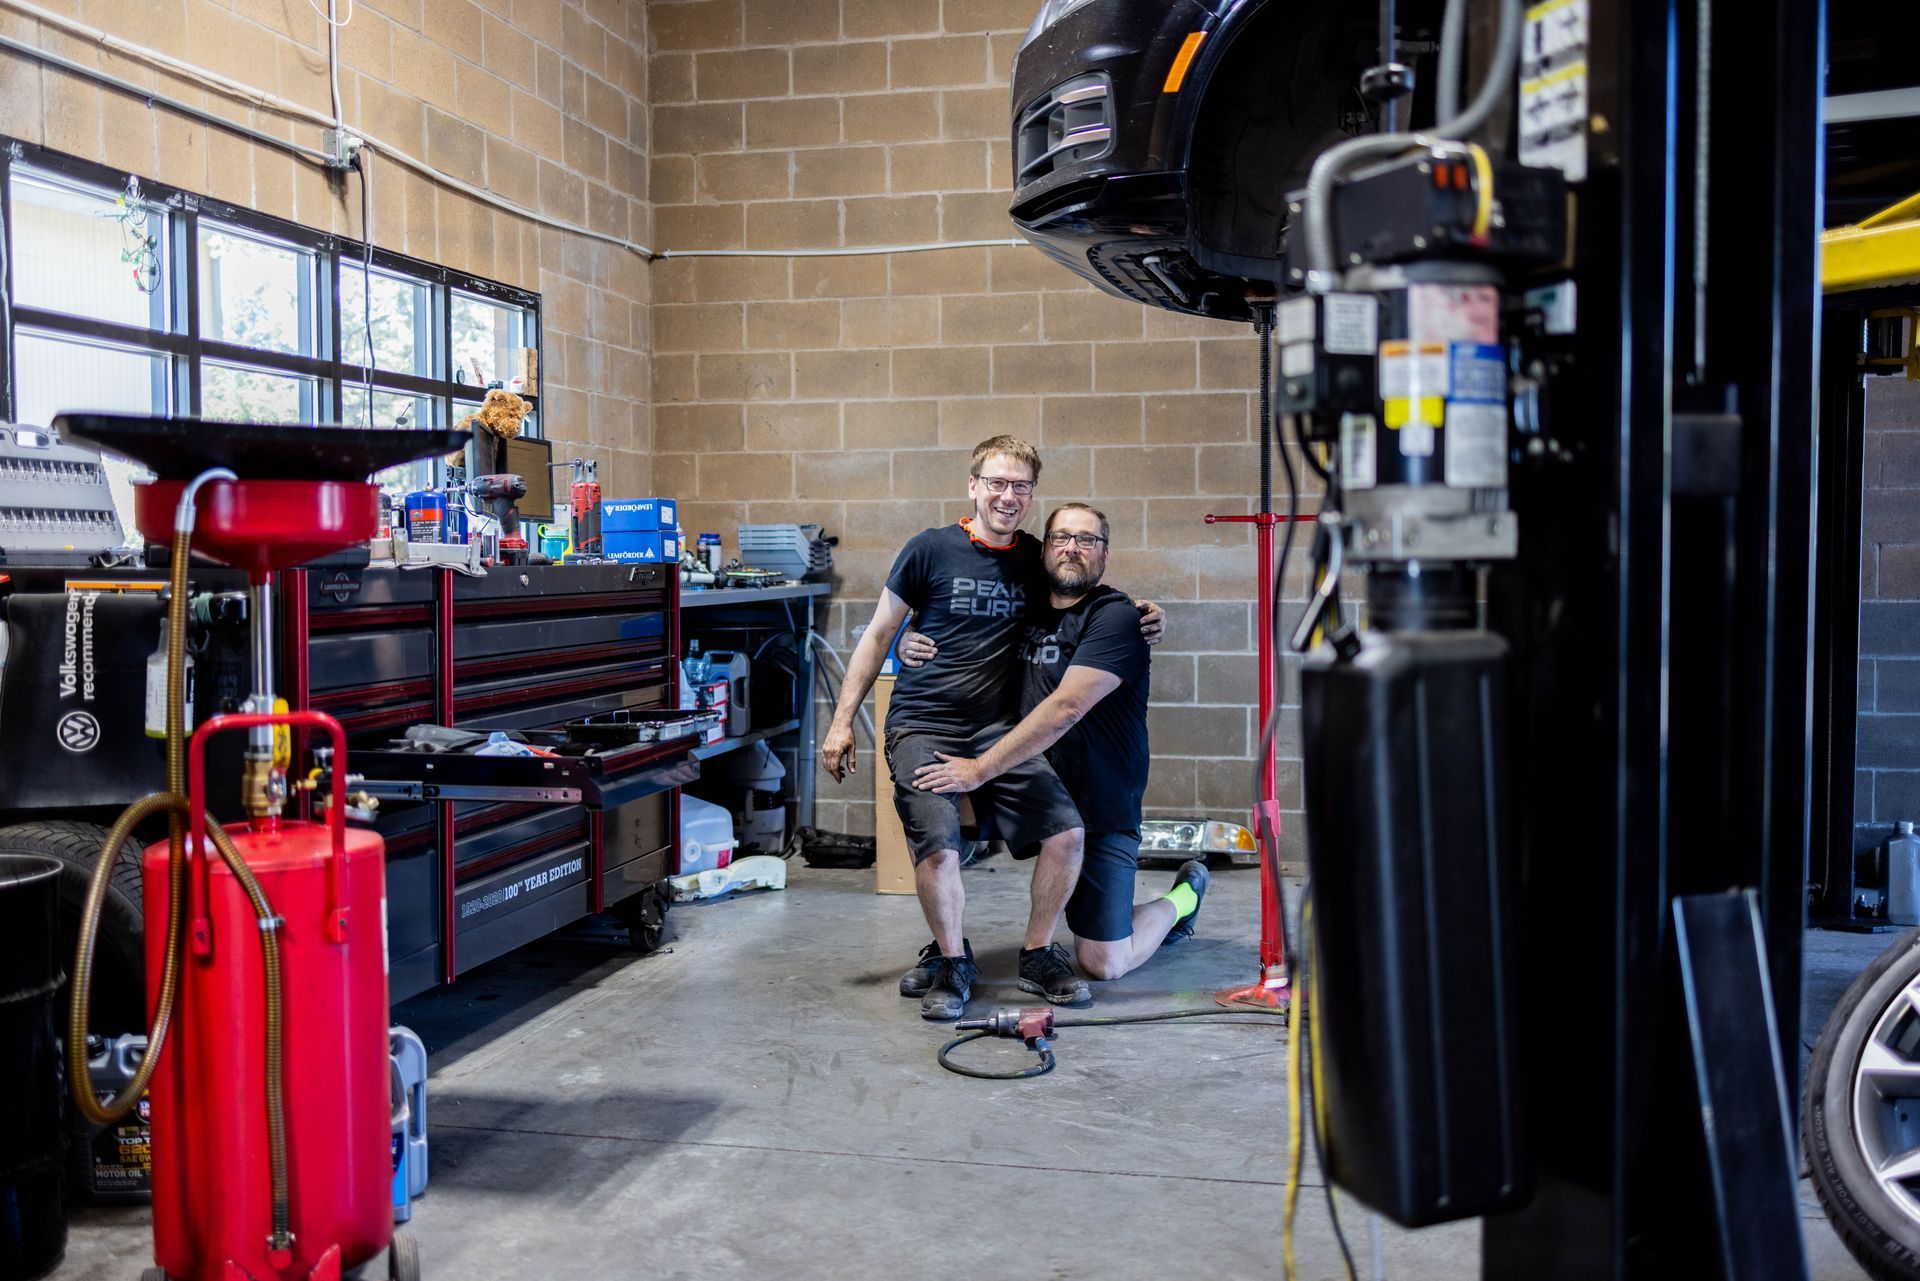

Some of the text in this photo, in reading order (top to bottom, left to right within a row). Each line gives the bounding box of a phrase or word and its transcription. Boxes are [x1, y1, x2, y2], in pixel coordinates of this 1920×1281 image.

[952, 577, 1025, 599] PEAK
[525, 872, 548, 892] YEAR
[549, 857, 582, 881] EDITION
[96, 1169, 144, 1178] MOTOR OIL
[1823, 1155, 1837, 1174] ALL
